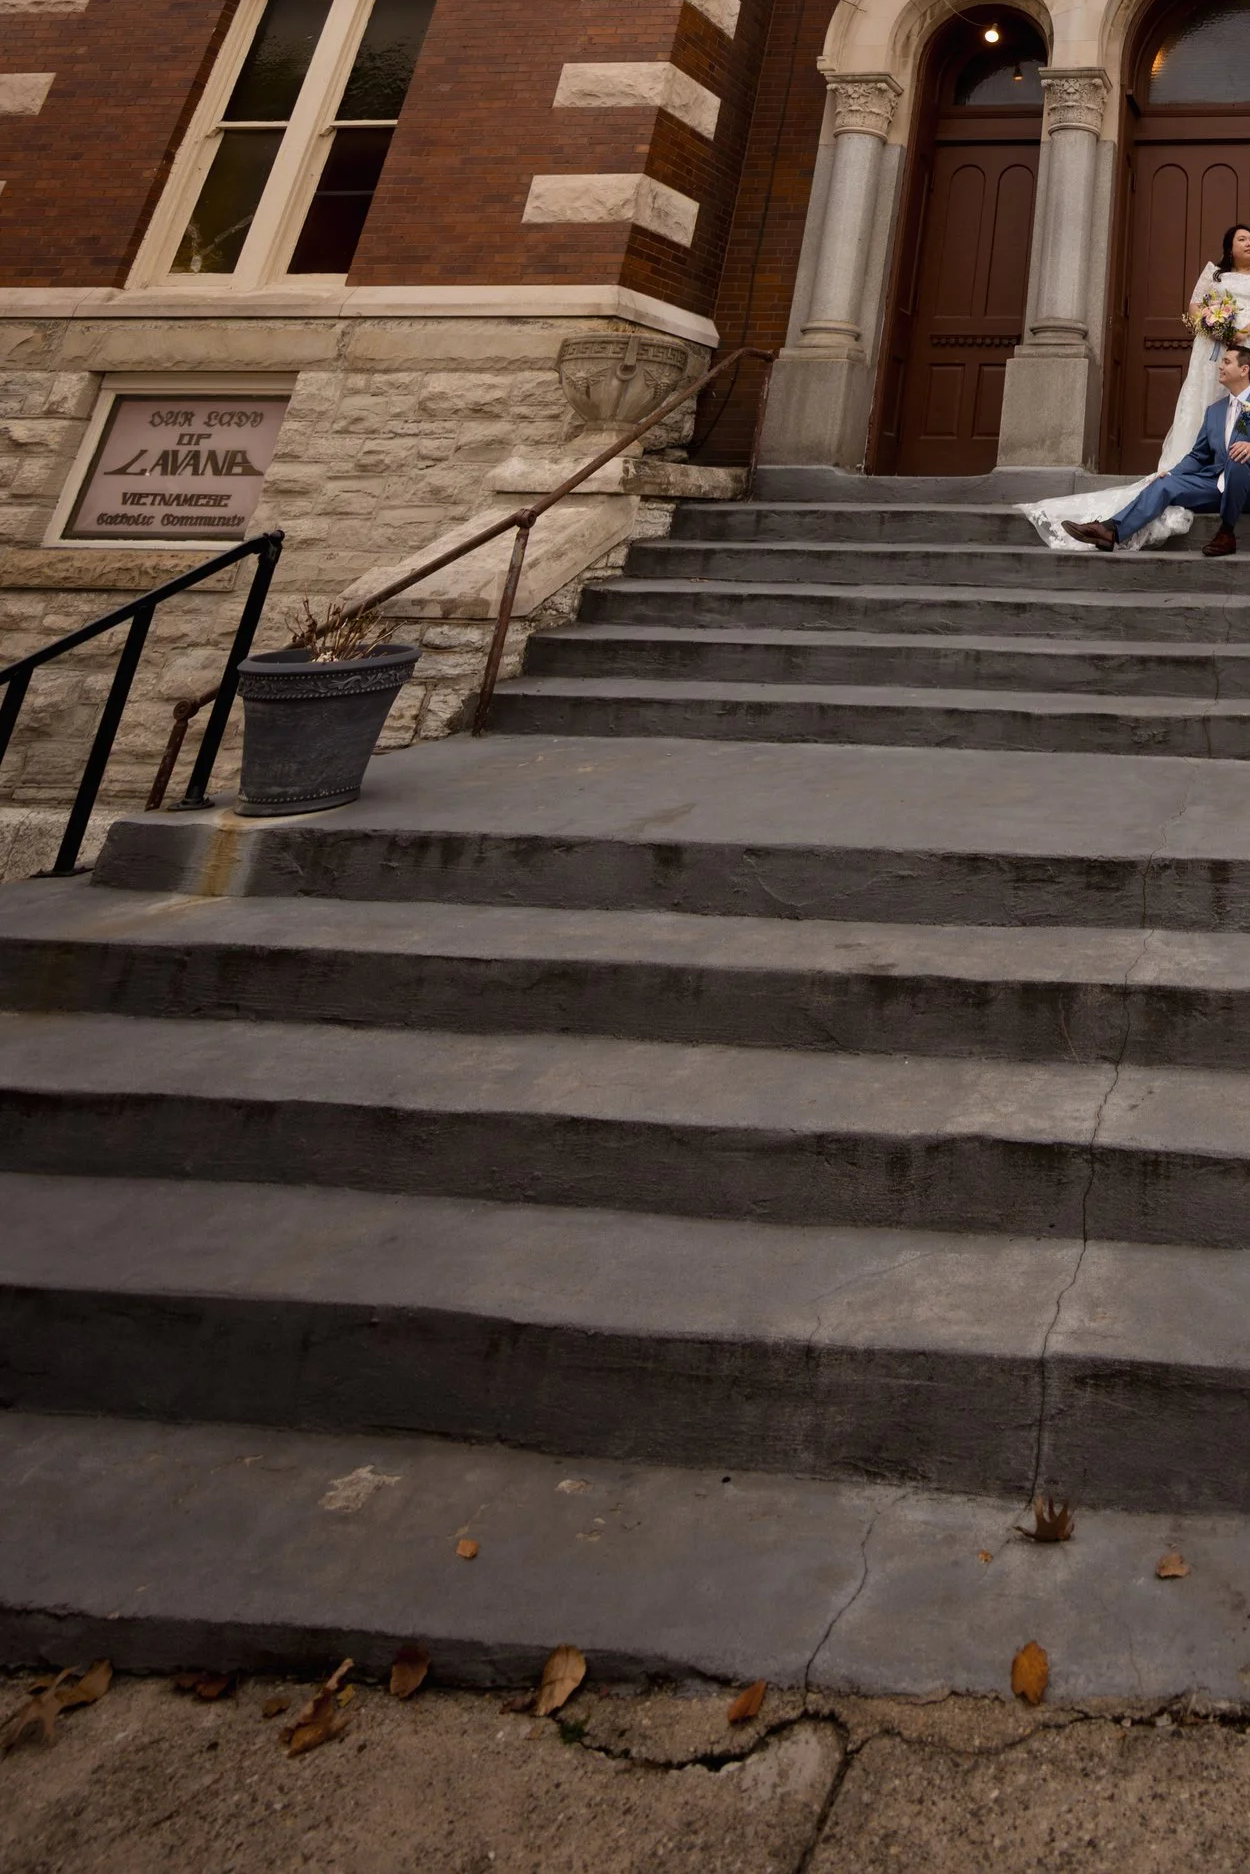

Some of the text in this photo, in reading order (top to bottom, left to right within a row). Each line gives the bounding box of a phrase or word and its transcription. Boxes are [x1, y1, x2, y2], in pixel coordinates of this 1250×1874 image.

[149, 410, 264, 427] OUR LADY
[176, 433, 212, 446] OF
[103, 449, 265, 476] LAVANG
[121, 492, 232, 507] VIETNAMESE
[96, 513, 245, 527] Catholic Community
